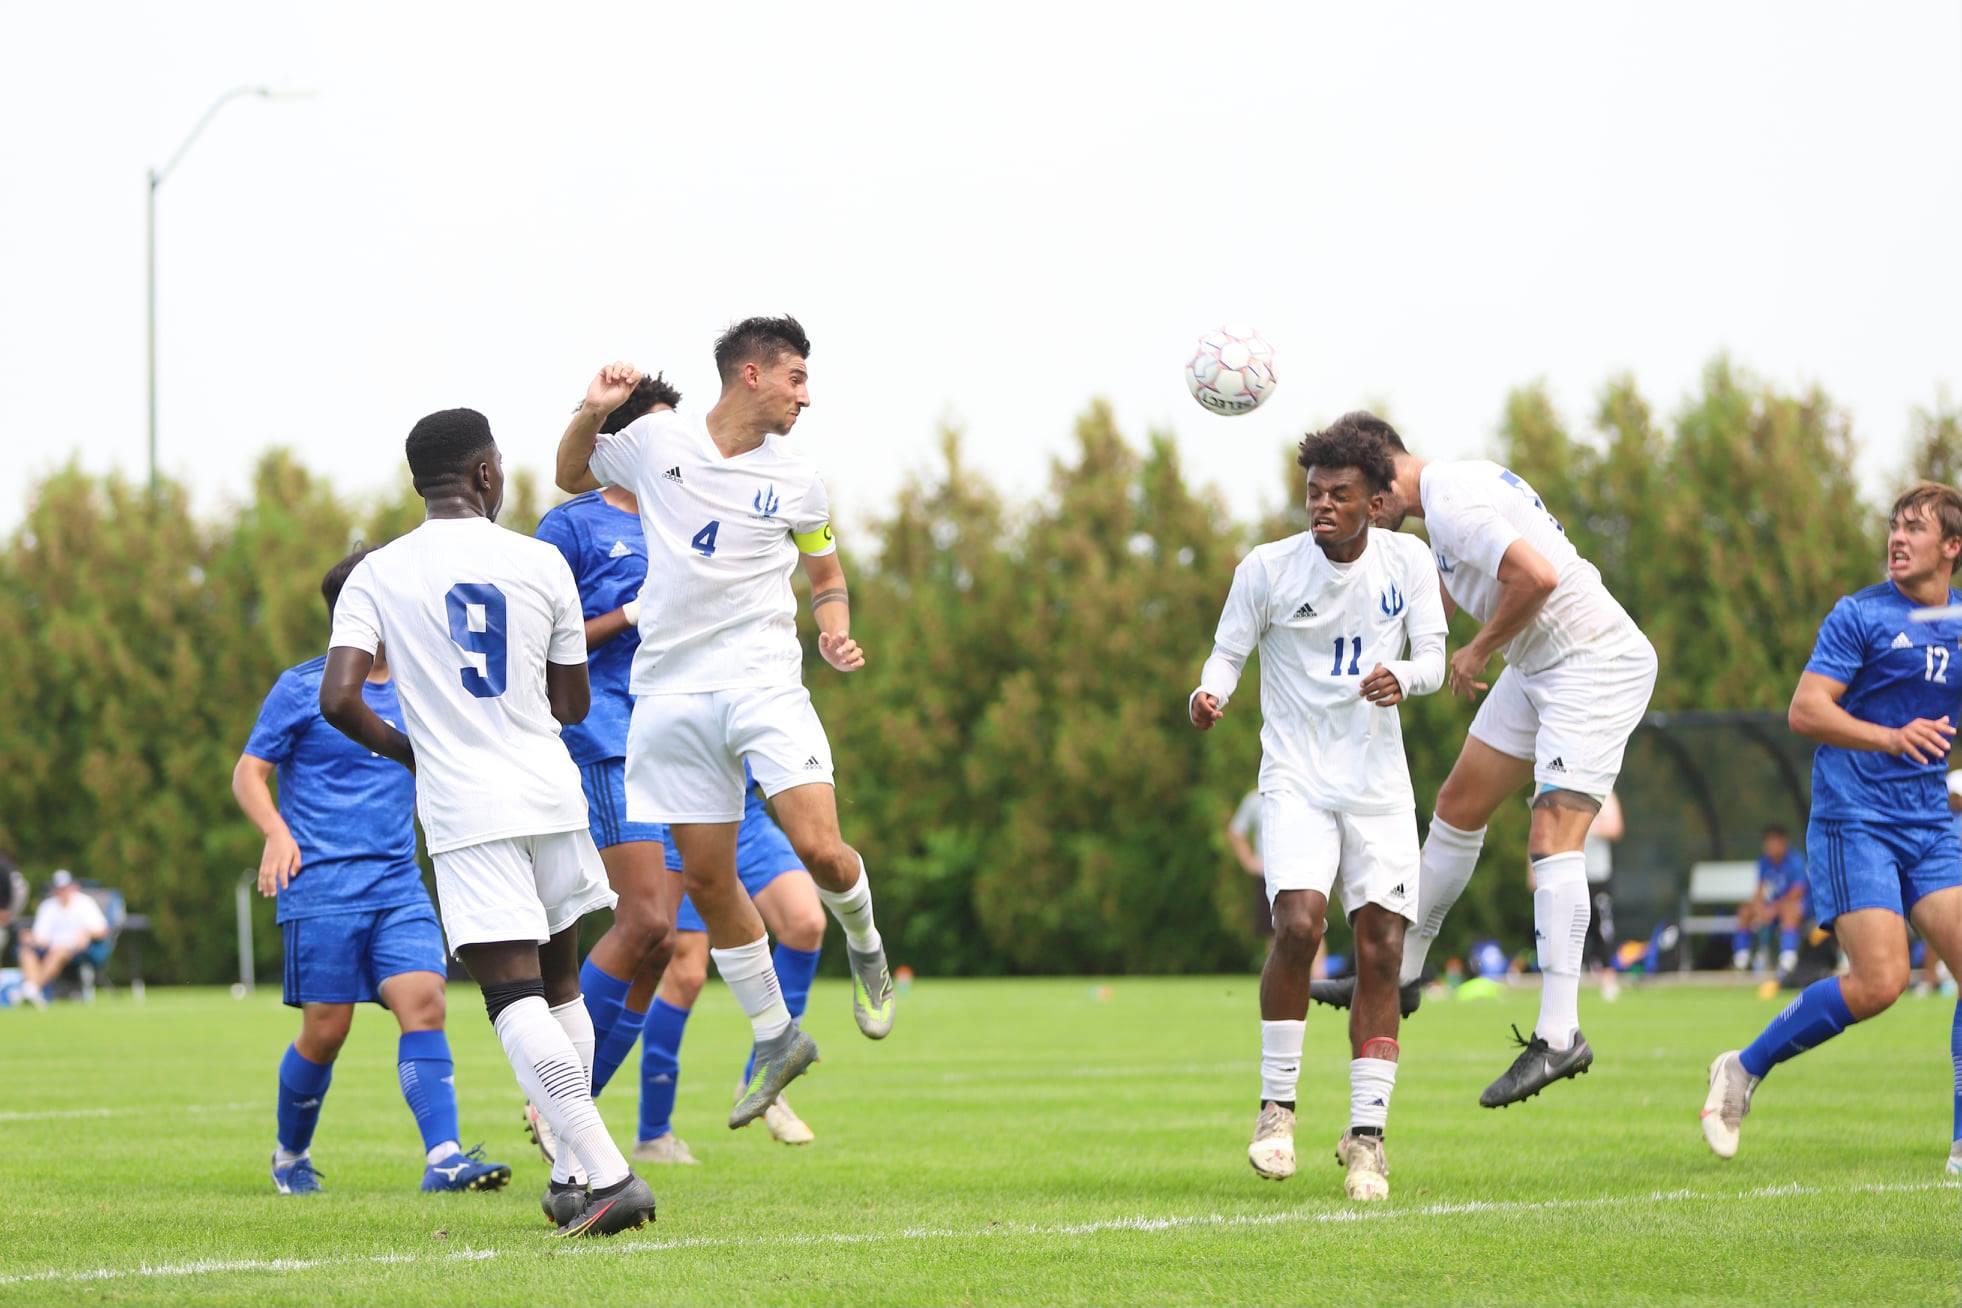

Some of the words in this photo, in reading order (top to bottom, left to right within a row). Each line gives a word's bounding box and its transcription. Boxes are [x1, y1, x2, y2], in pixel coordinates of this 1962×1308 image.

[691, 520, 720, 558] 4
[445, 583, 507, 698] 9
[1331, 637, 1361, 676] 11
[1925, 644, 1950, 684] 12
